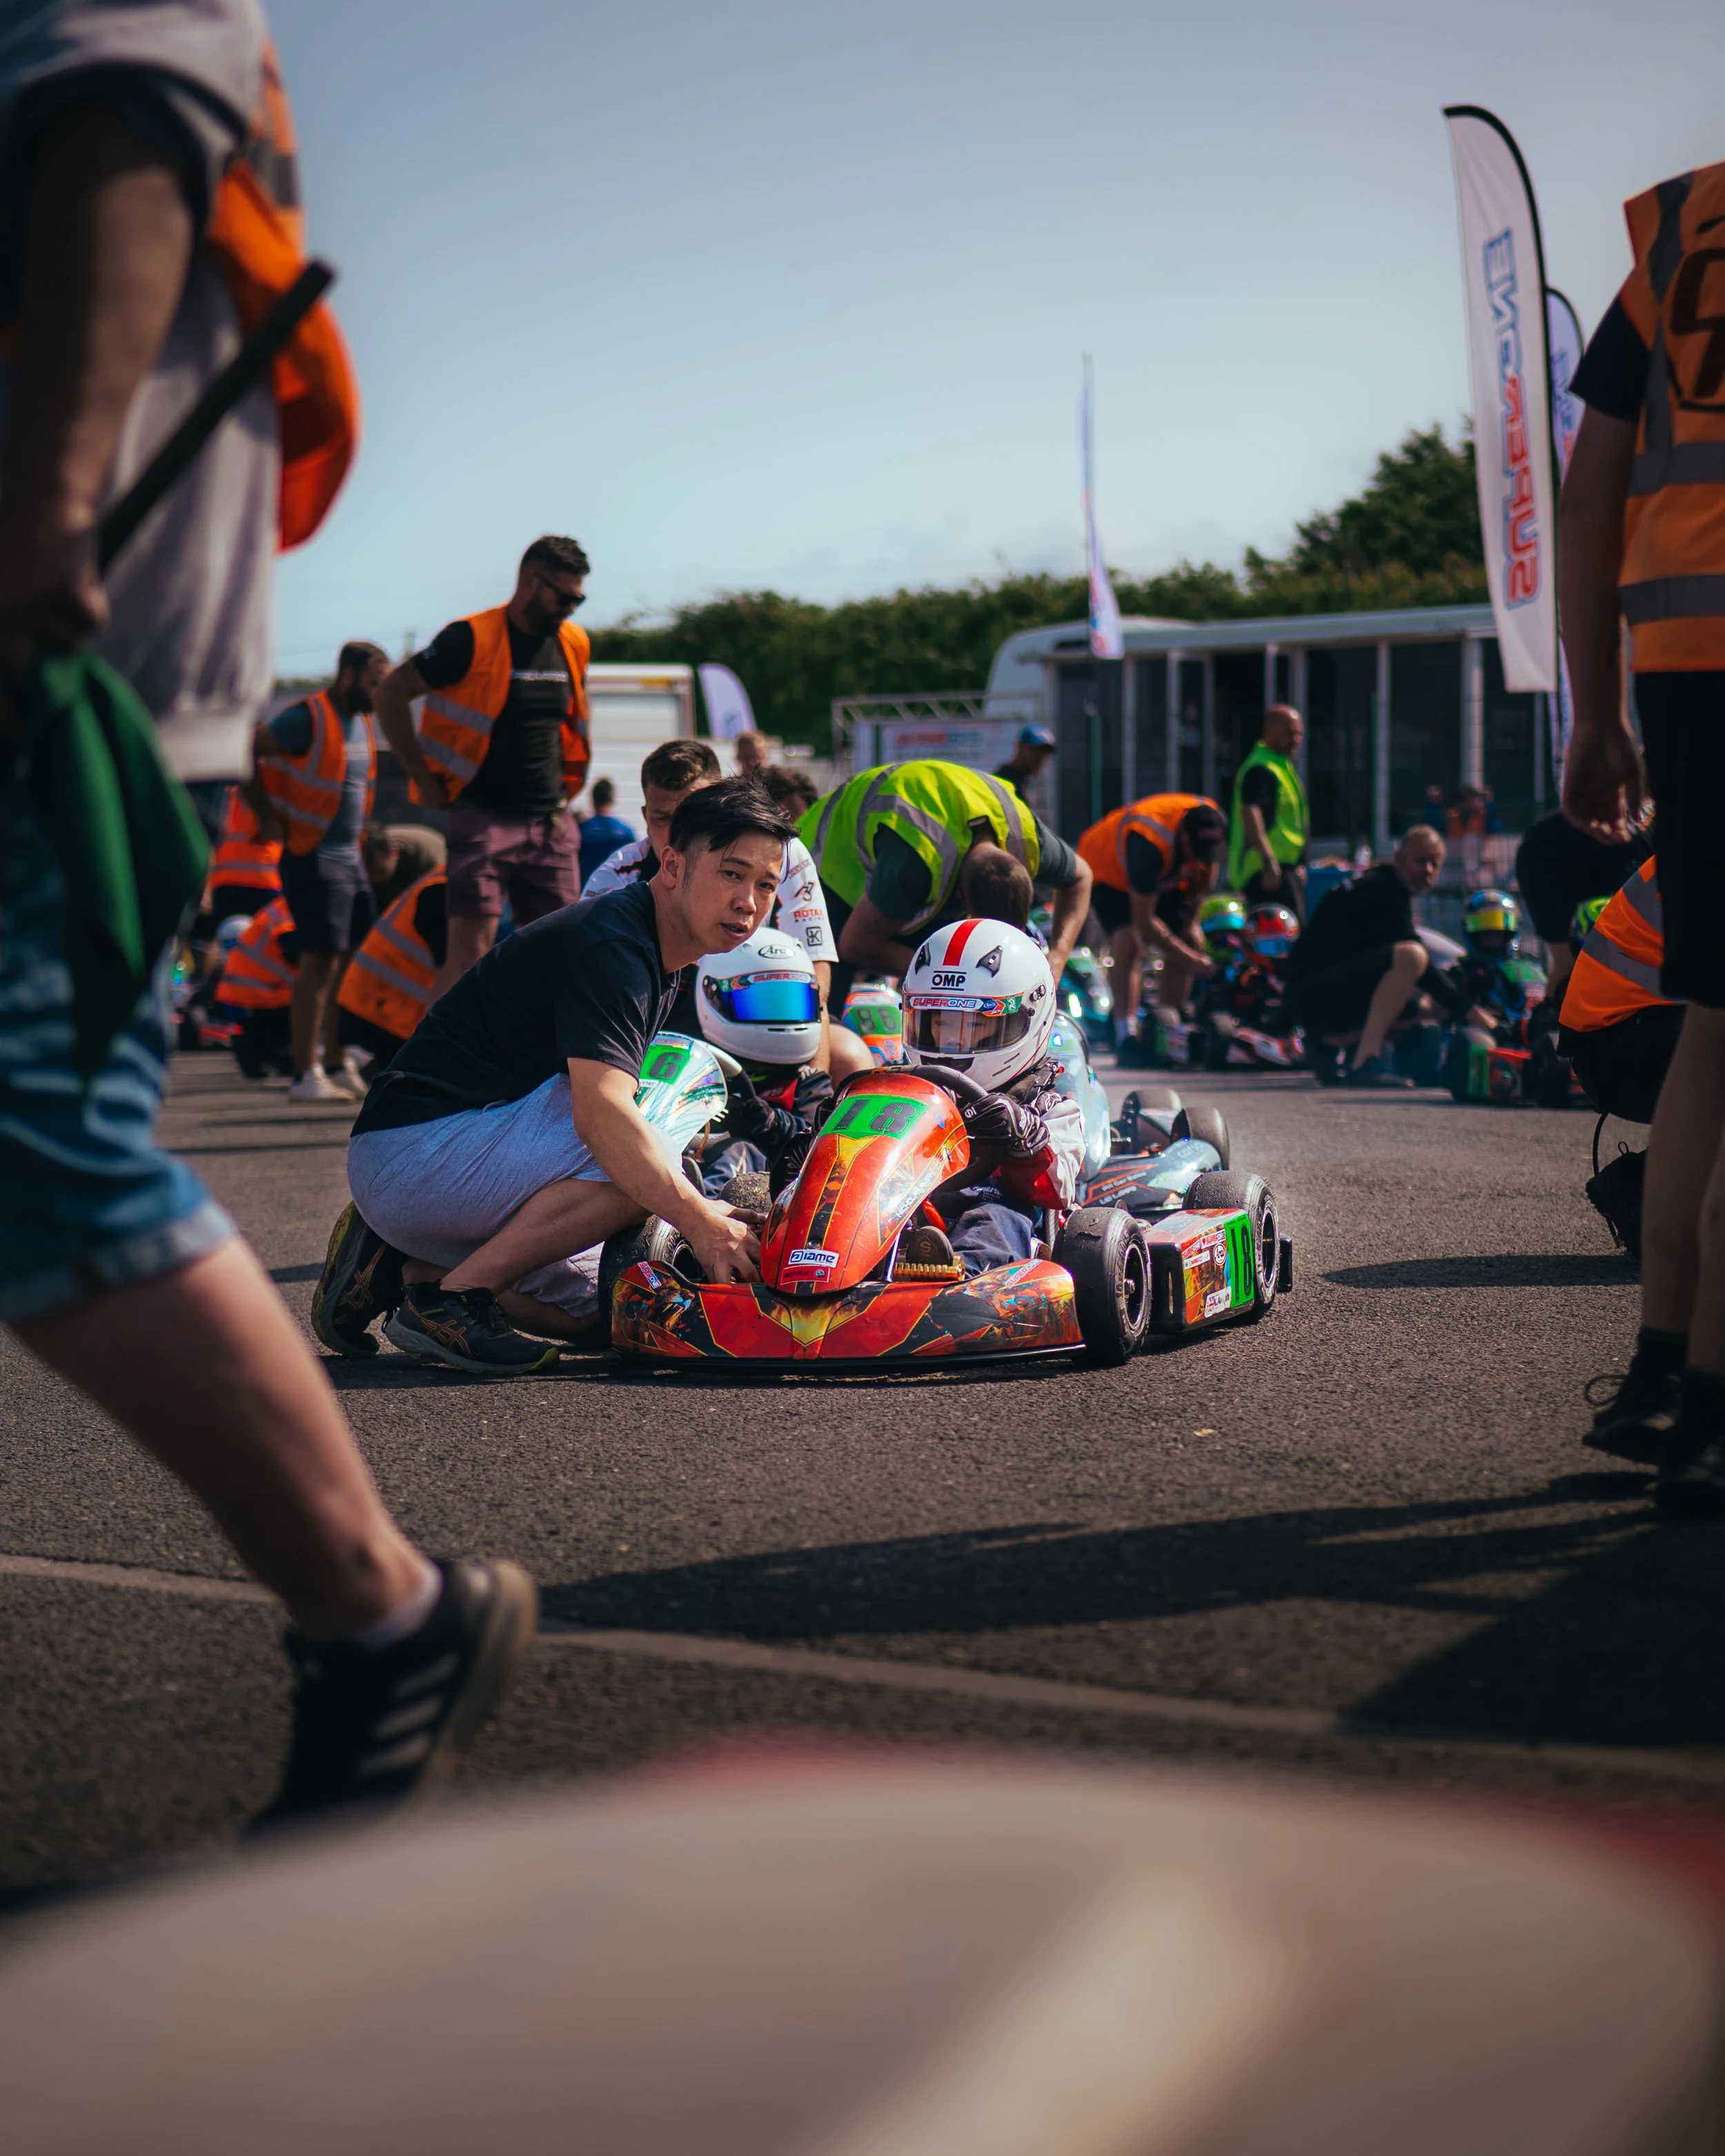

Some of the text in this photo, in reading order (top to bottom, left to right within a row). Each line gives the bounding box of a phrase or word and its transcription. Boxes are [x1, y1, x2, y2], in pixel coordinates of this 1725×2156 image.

[932, 973, 966, 987] OMP
[912, 998, 978, 1009] SUPERONE
[857, 1007, 898, 1033] 86
[833, 1099, 917, 1134] 18
[1230, 1224, 1253, 1303] 18
